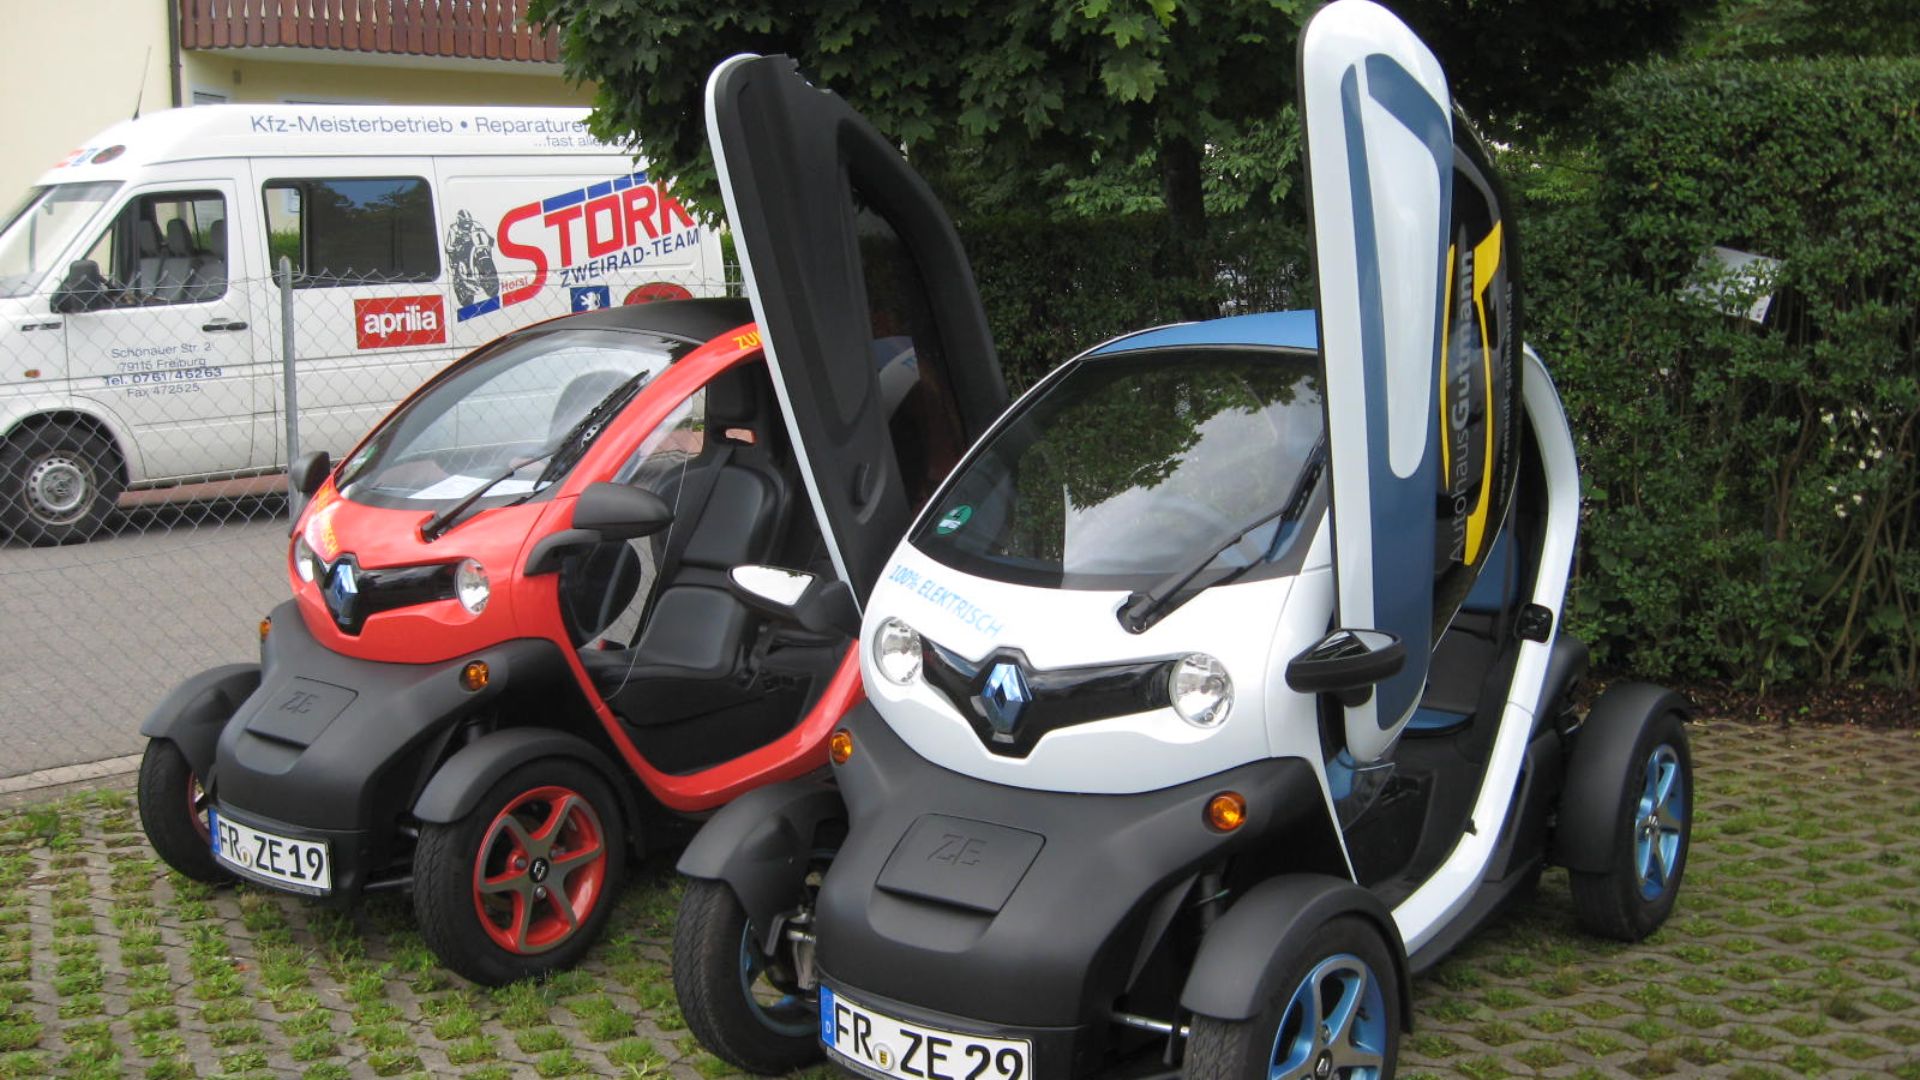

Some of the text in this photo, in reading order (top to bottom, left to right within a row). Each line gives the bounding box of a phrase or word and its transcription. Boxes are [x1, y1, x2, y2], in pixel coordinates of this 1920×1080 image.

[251, 116, 588, 134] Kfz-Meisterbetrieb Reparature
[497, 179, 696, 308] STORK
[560, 228, 700, 288] ZWEIRAD-TEAM
[364, 305, 437, 338] aprilia
[917, 579, 1004, 639] ELEKTRISCH
[219, 820, 242, 861] FR
[835, 1002, 873, 1061] FR
